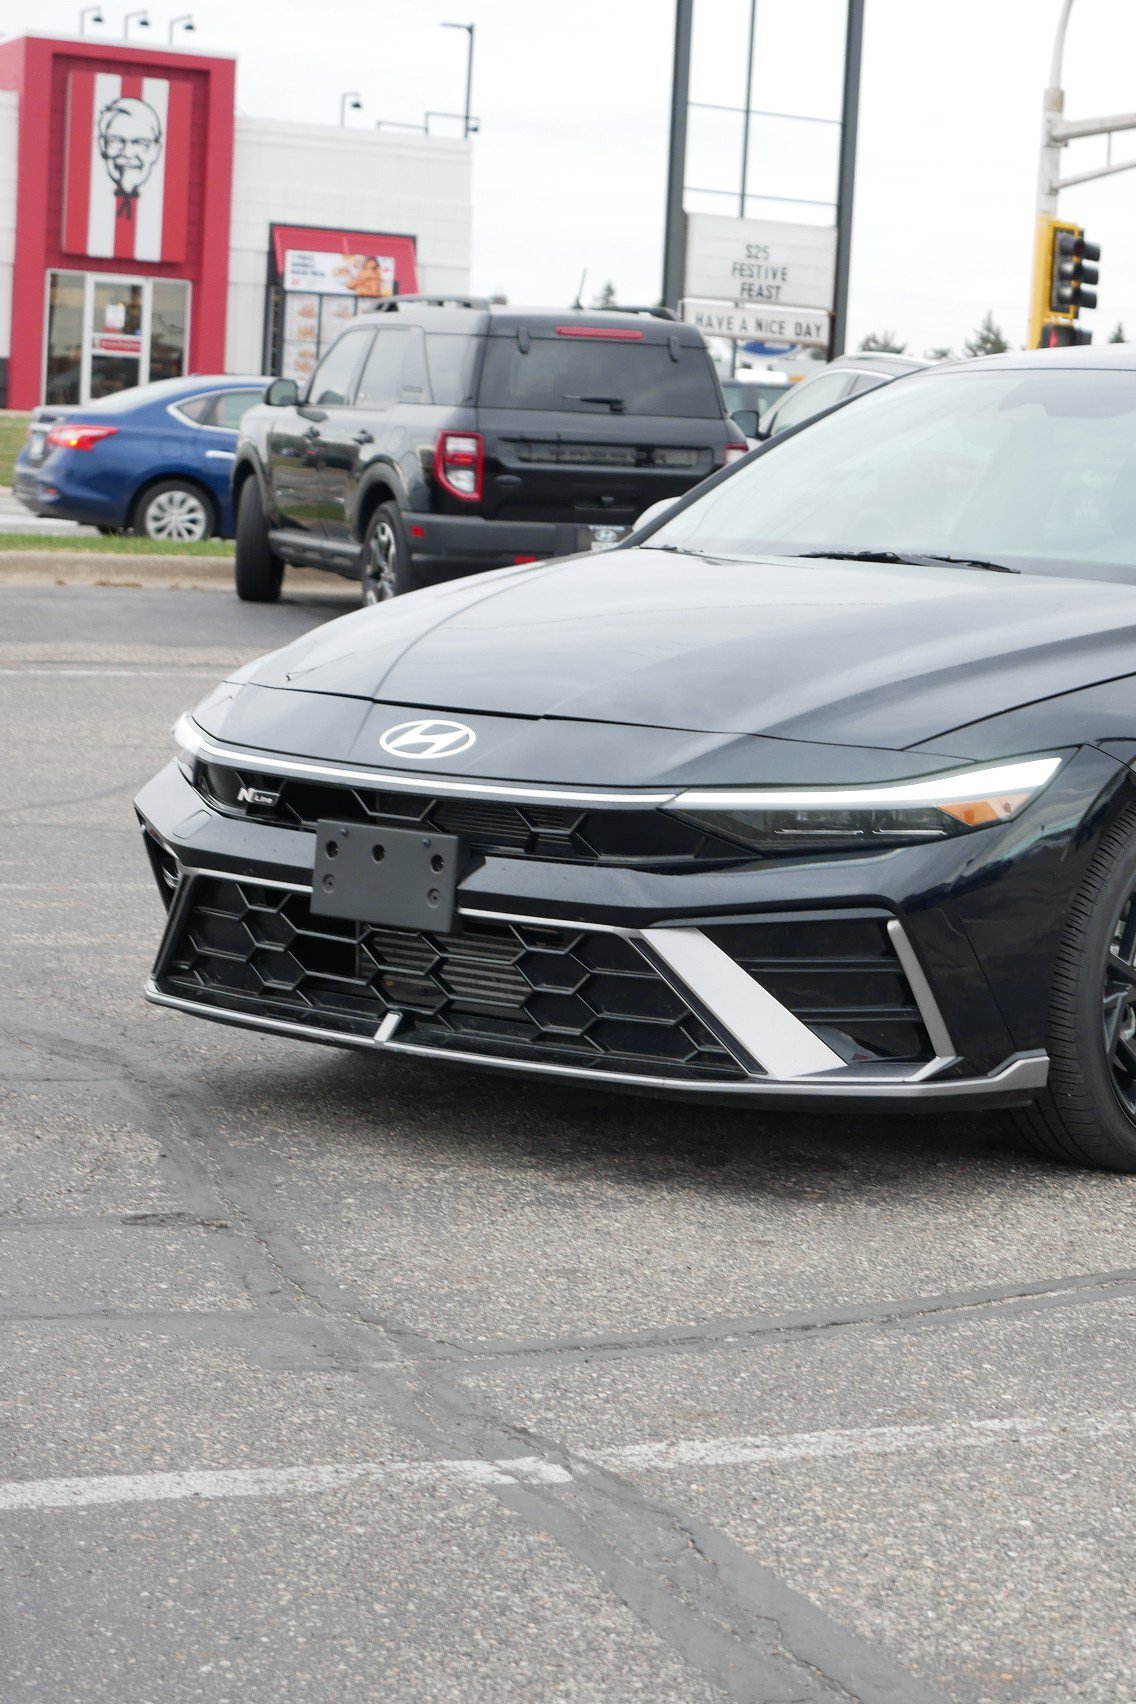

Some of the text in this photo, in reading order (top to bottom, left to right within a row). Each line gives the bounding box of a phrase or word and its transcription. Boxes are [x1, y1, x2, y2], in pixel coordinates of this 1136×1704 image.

[732, 262, 788, 281] FESTIVE
[740, 282, 782, 300] FEAST
[696, 312, 822, 337] HAVE A NICE DAY
